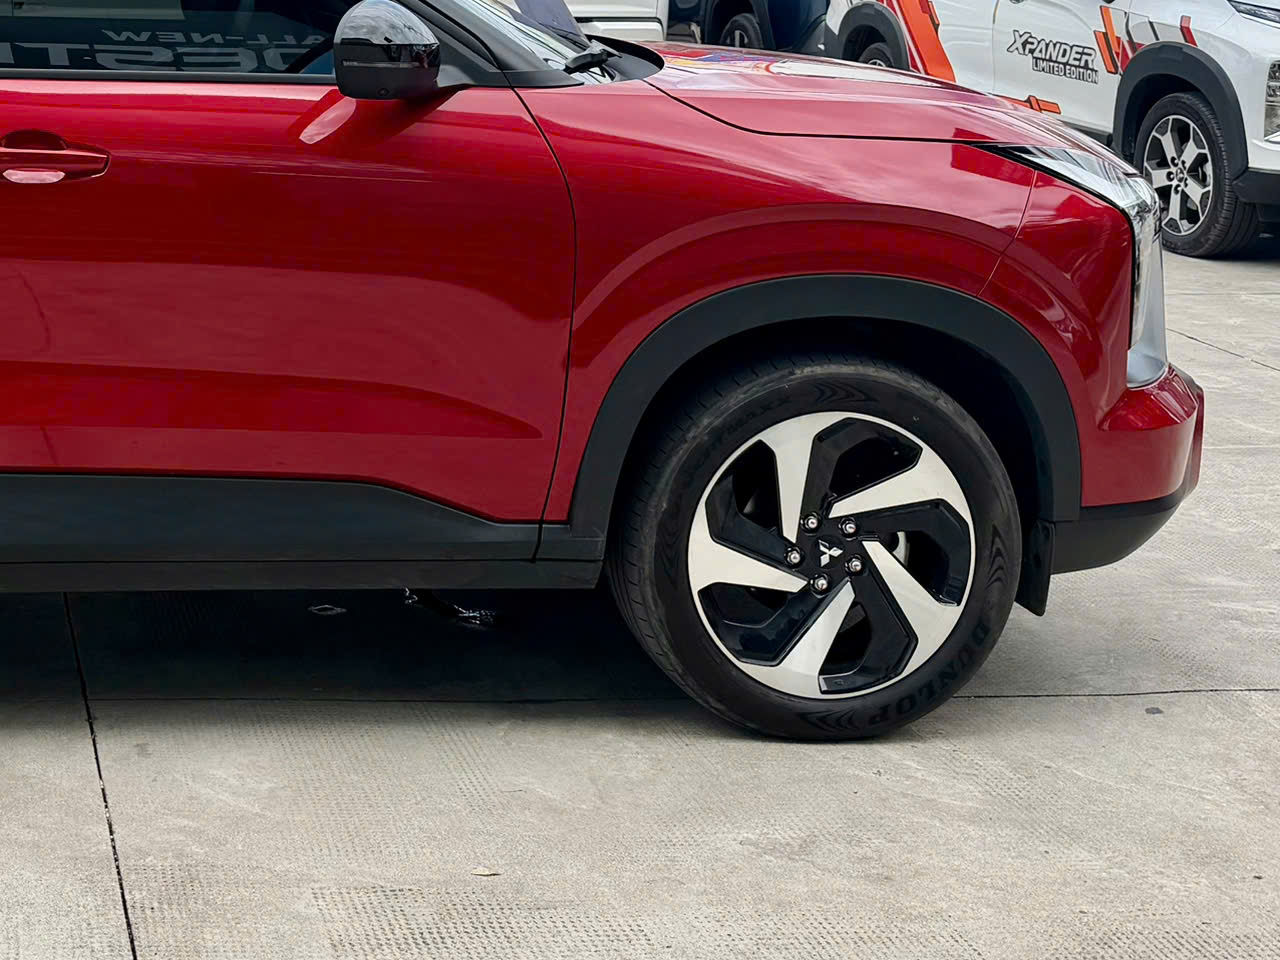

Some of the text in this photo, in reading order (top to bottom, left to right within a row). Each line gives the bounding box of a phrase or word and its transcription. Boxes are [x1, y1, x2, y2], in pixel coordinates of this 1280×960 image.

[1007, 29, 1098, 68] XPANDER
[1031, 57, 1099, 85] LIMITED EDITION
[869, 616, 991, 726] DUNLOP
